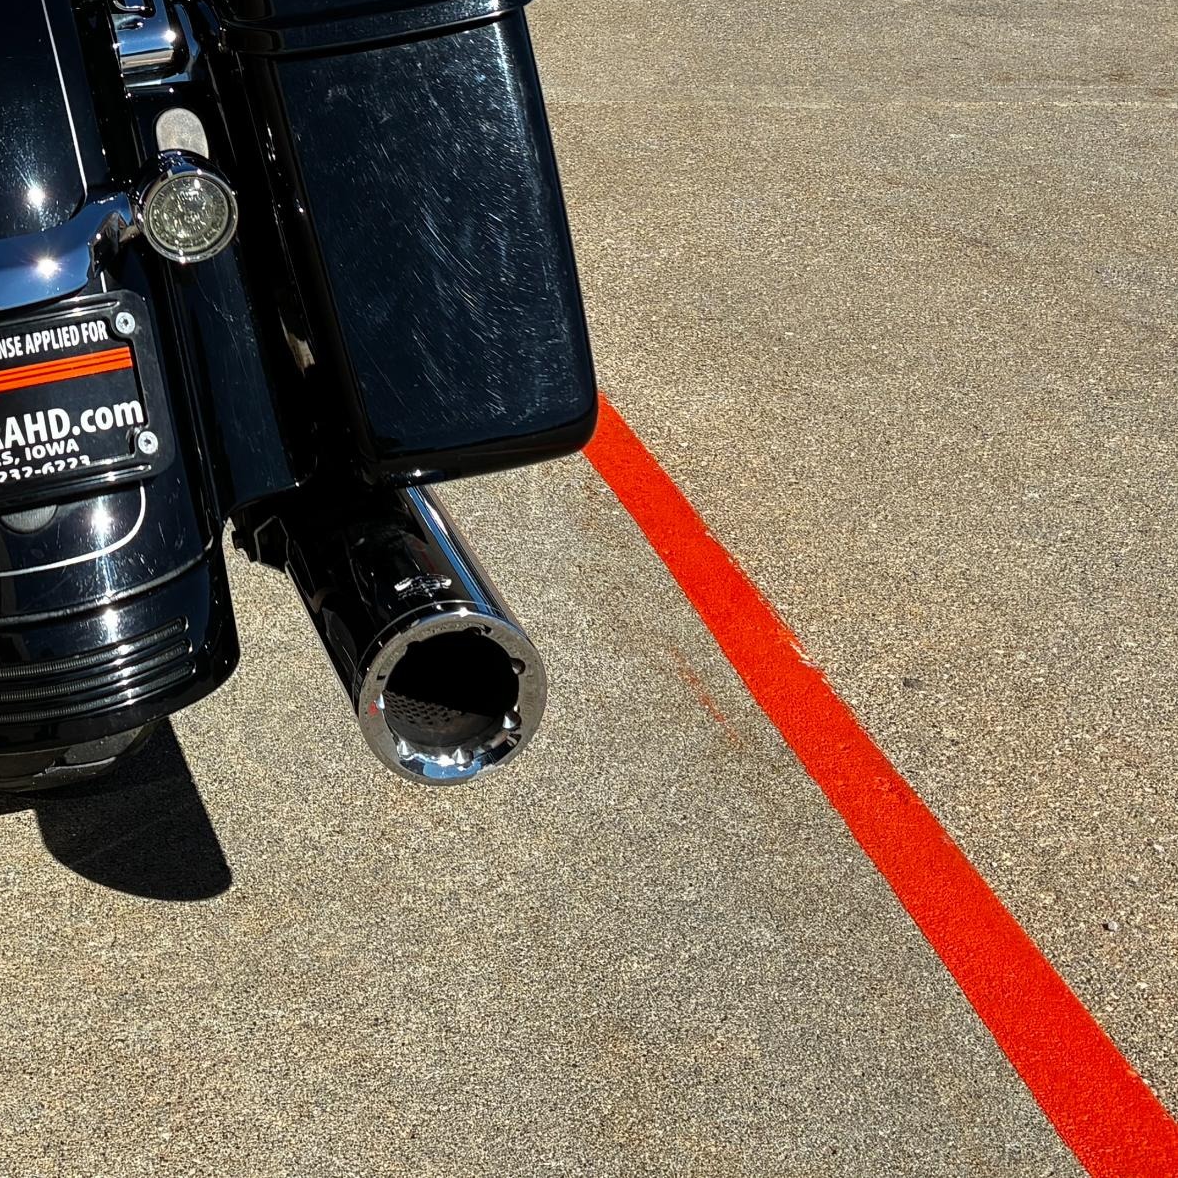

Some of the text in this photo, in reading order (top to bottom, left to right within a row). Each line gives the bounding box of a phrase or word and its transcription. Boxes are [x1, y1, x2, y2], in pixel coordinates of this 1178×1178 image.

[25, 326, 81, 355] APPLIED
[82, 320, 109, 343] FOR
[25, 438, 80, 462] IOWA
